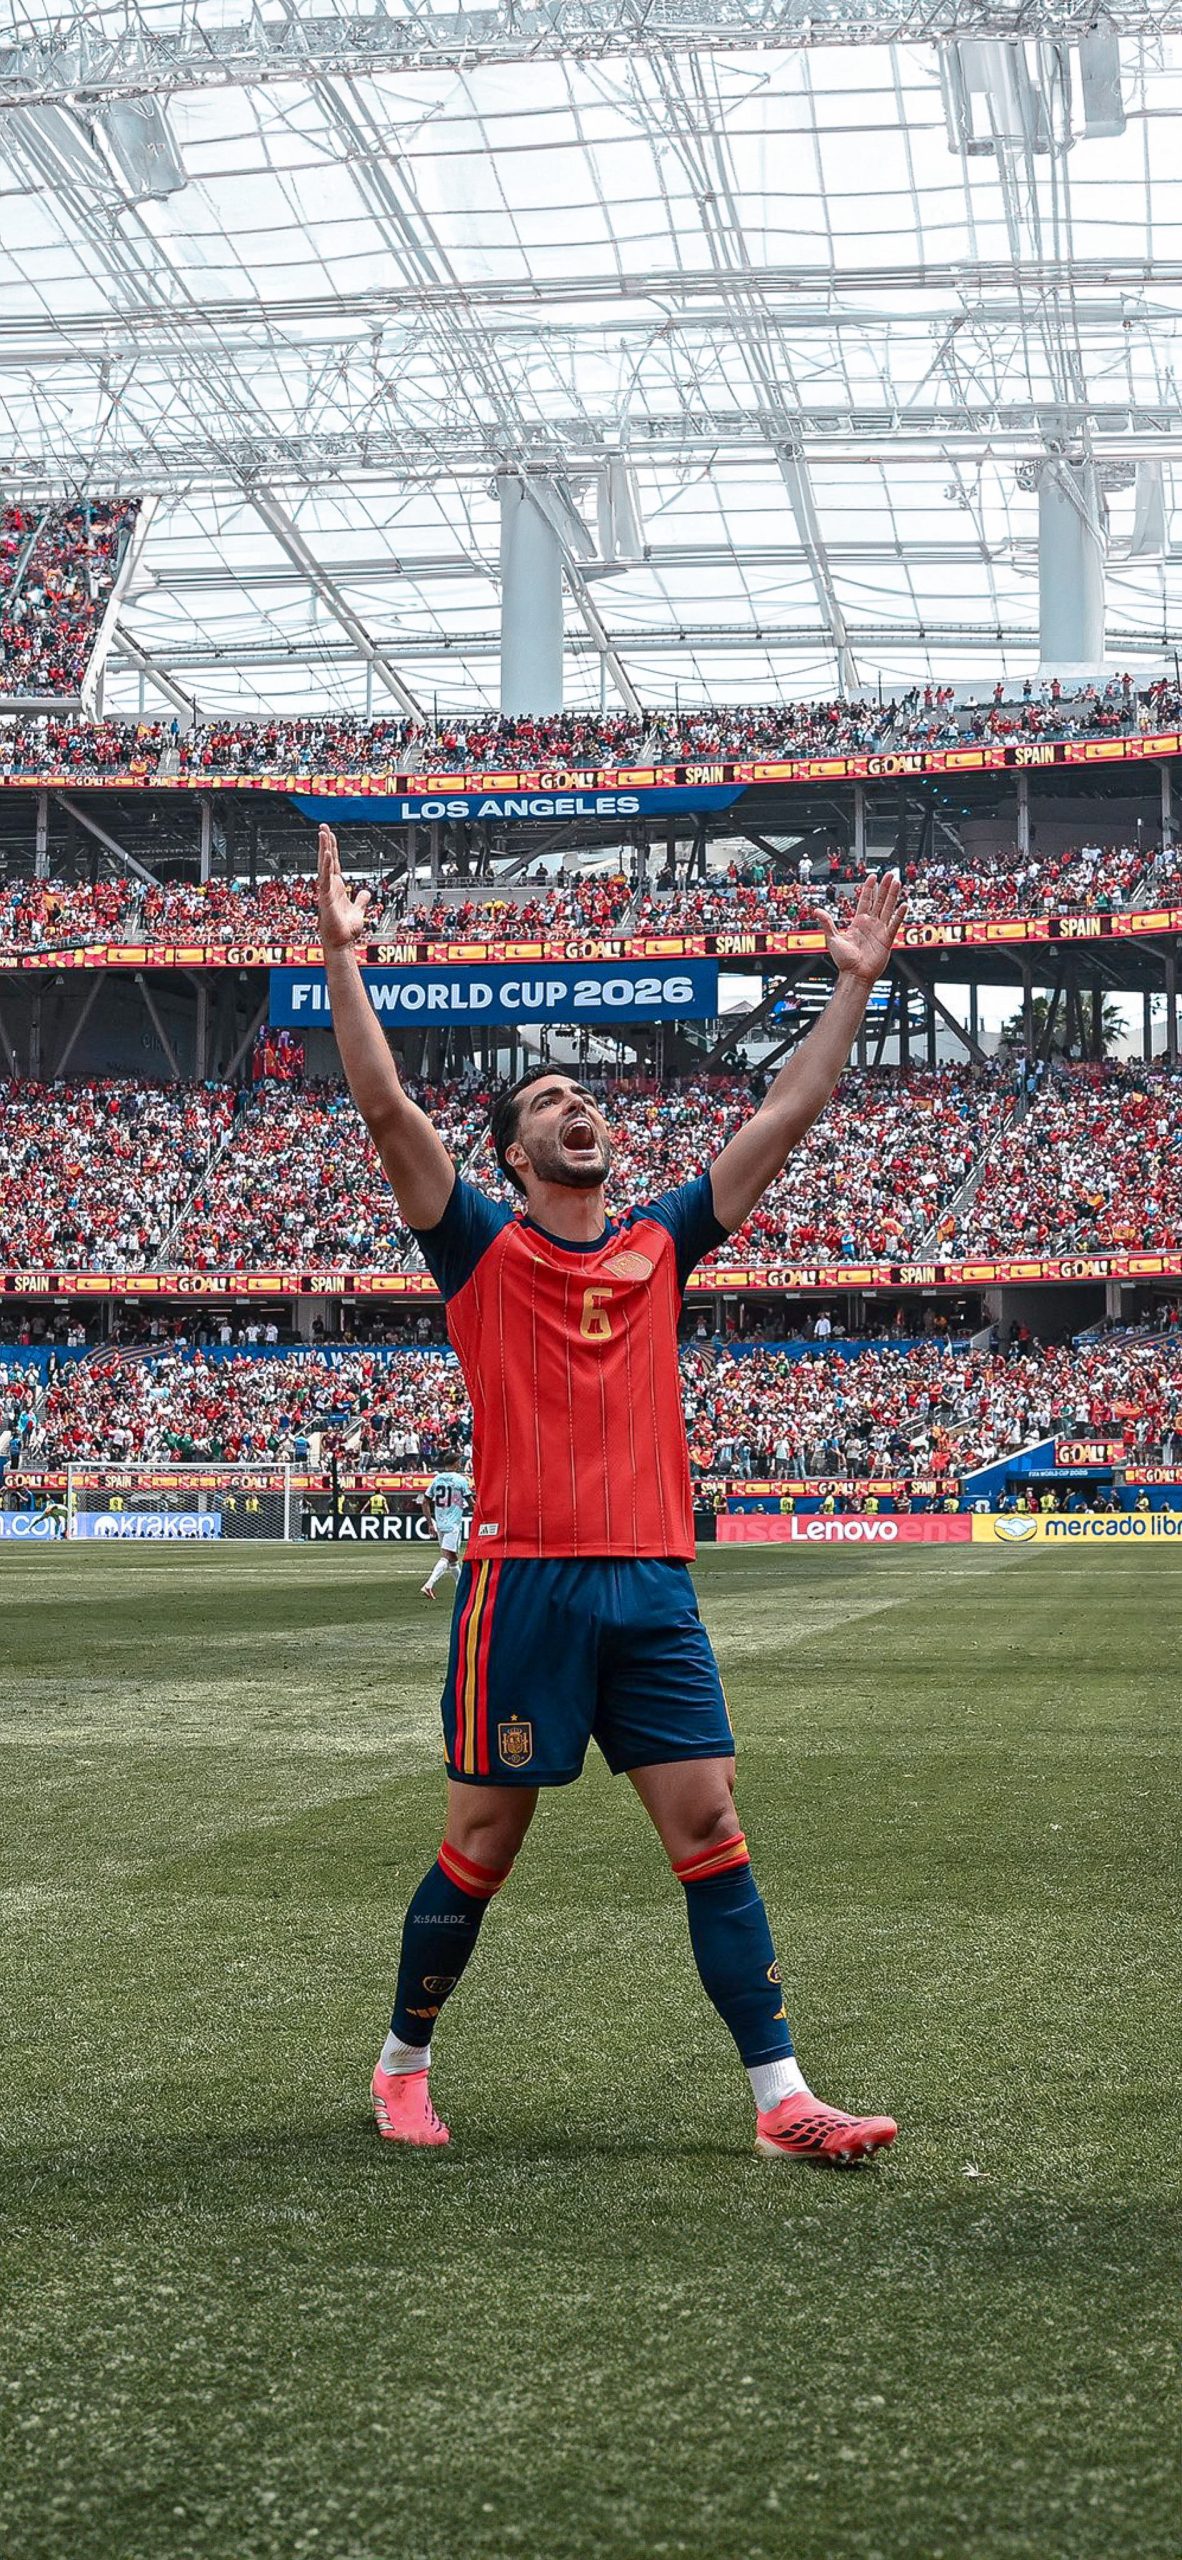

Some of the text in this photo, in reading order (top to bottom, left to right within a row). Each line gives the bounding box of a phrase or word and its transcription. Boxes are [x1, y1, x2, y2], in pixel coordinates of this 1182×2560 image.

[1015, 746, 1055, 765] SPAIN
[685, 765, 724, 785] SPAIN
[868, 756, 921, 775] GOAL!
[541, 772, 594, 790] GOAL!
[401, 796, 640, 820] LOS ANGELES
[906, 925, 962, 945] GOAL!
[1059, 917, 1101, 938] SPAIN
[377, 945, 418, 963] SPAIN
[565, 940, 622, 959] GOAL!
[716, 935, 756, 954] SPAIN
[228, 946, 282, 964] GOAL!
[291, 977, 693, 1010] FI WORLD CUP 2026
[767, 1269, 817, 1287] GOAL!
[899, 1266, 935, 1284] SPAIN
[1061, 1260, 1108, 1278] GOAL!
[14, 1276, 49, 1292] SPAIN
[178, 1275, 227, 1292] GOAL!
[310, 1276, 345, 1292] SPAIN
[580, 1287, 612, 1340] 6
[1059, 1444, 1104, 1464] GOAL!
[105, 1475, 131, 1487] SPAIN
[435, 1485, 452, 1507] 21
[122, 1514, 214, 1537] kraken
[310, 1516, 472, 1539] MARRIOT
[791, 1516, 898, 1541] Lenovo
[1045, 1516, 1146, 1536] mercado
